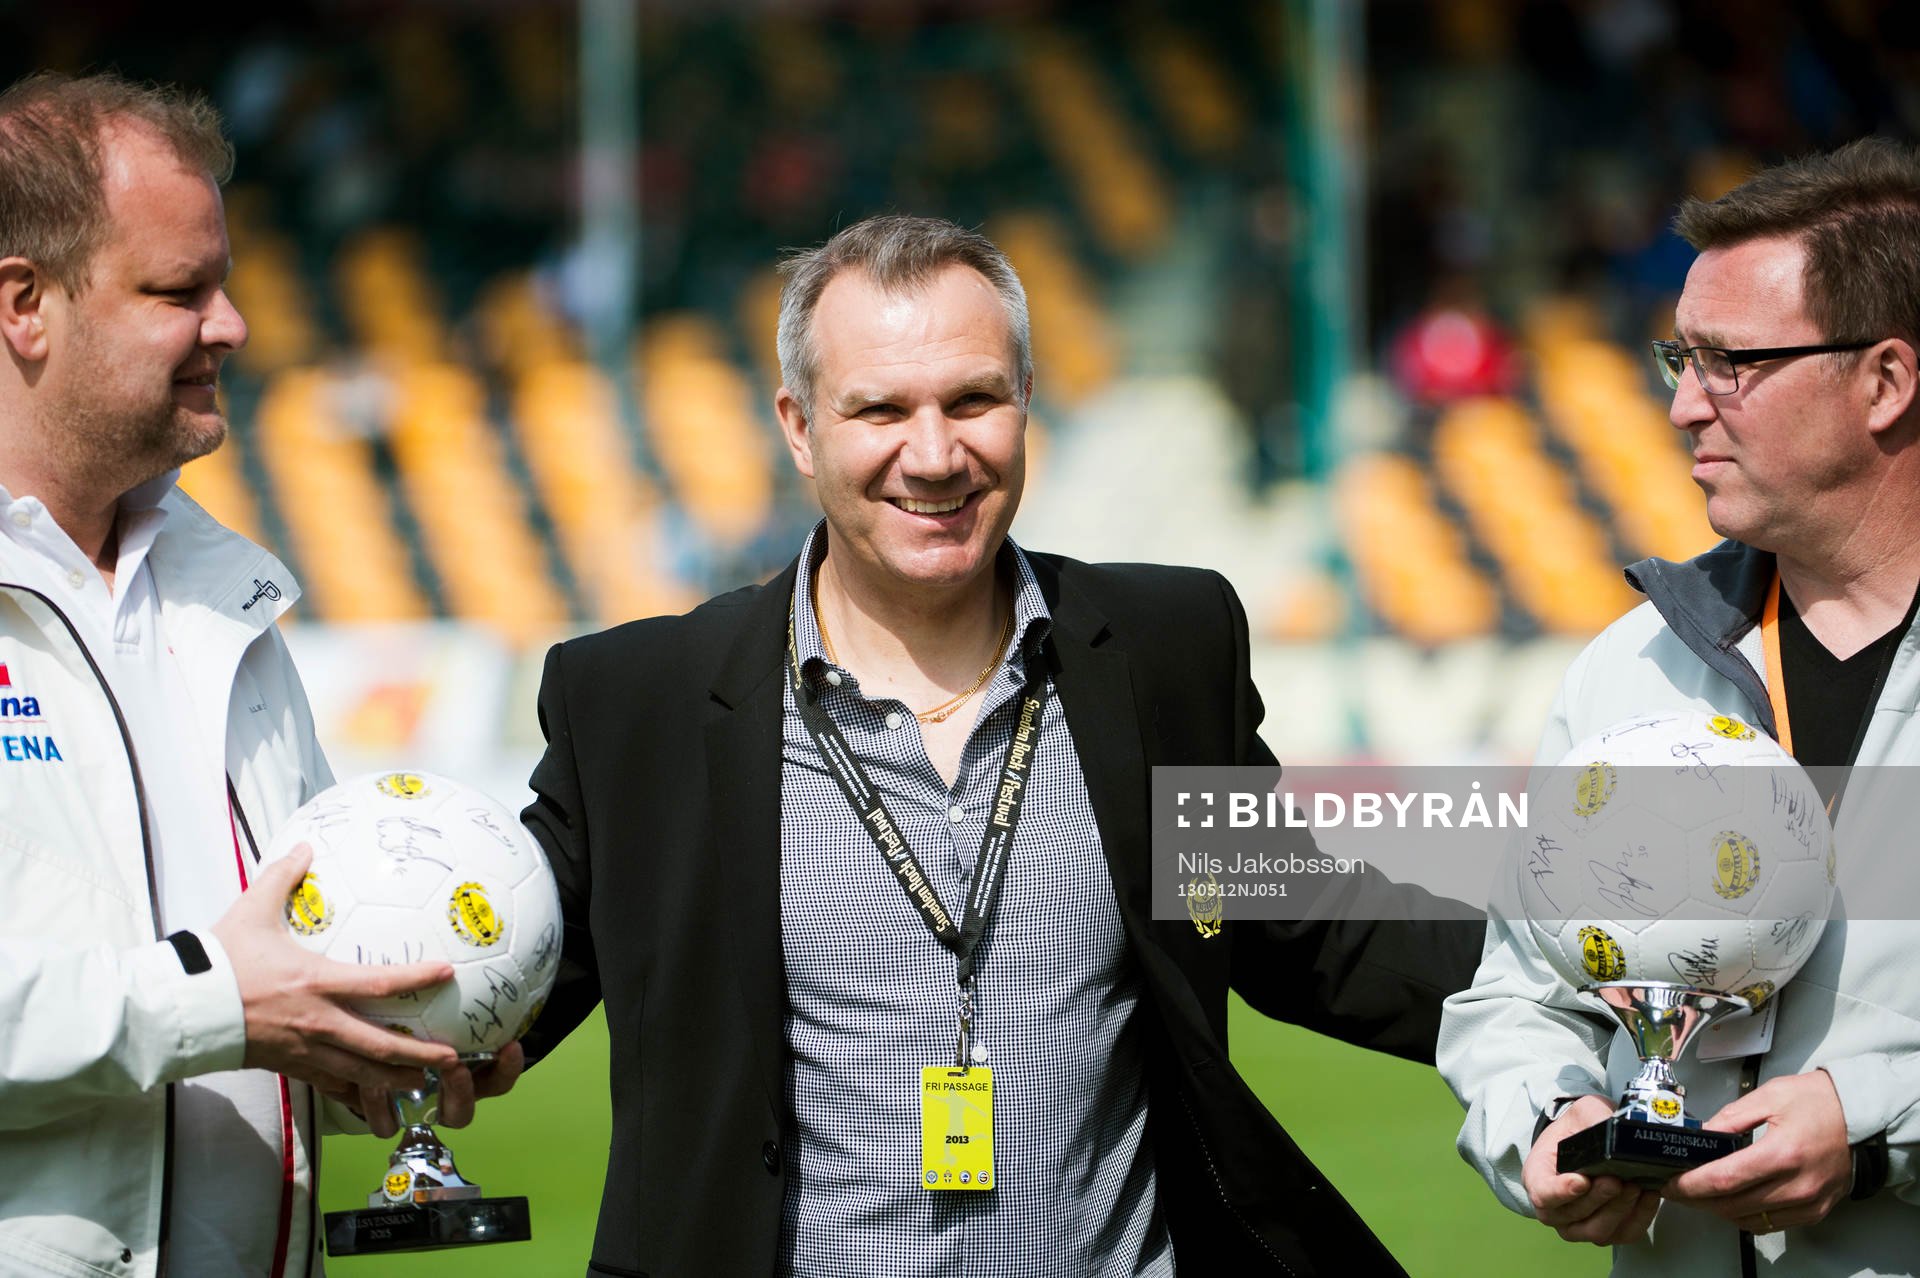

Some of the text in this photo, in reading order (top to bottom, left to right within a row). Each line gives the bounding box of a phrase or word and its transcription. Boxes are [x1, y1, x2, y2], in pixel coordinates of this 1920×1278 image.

[0, 735, 64, 761] ENA
[993, 697, 1040, 827] Sweden Rock Festival
[998, 831, 1007, 845] FILL
[993, 846, 1003, 864] YOUR
[866, 807, 951, 932] Sweden Rock Festival
[925, 1082, 989, 1092] FRI PASSAGE
[945, 1135, 970, 1144] 2013
[1634, 1128, 1719, 1149] ALLSVENSKAN
